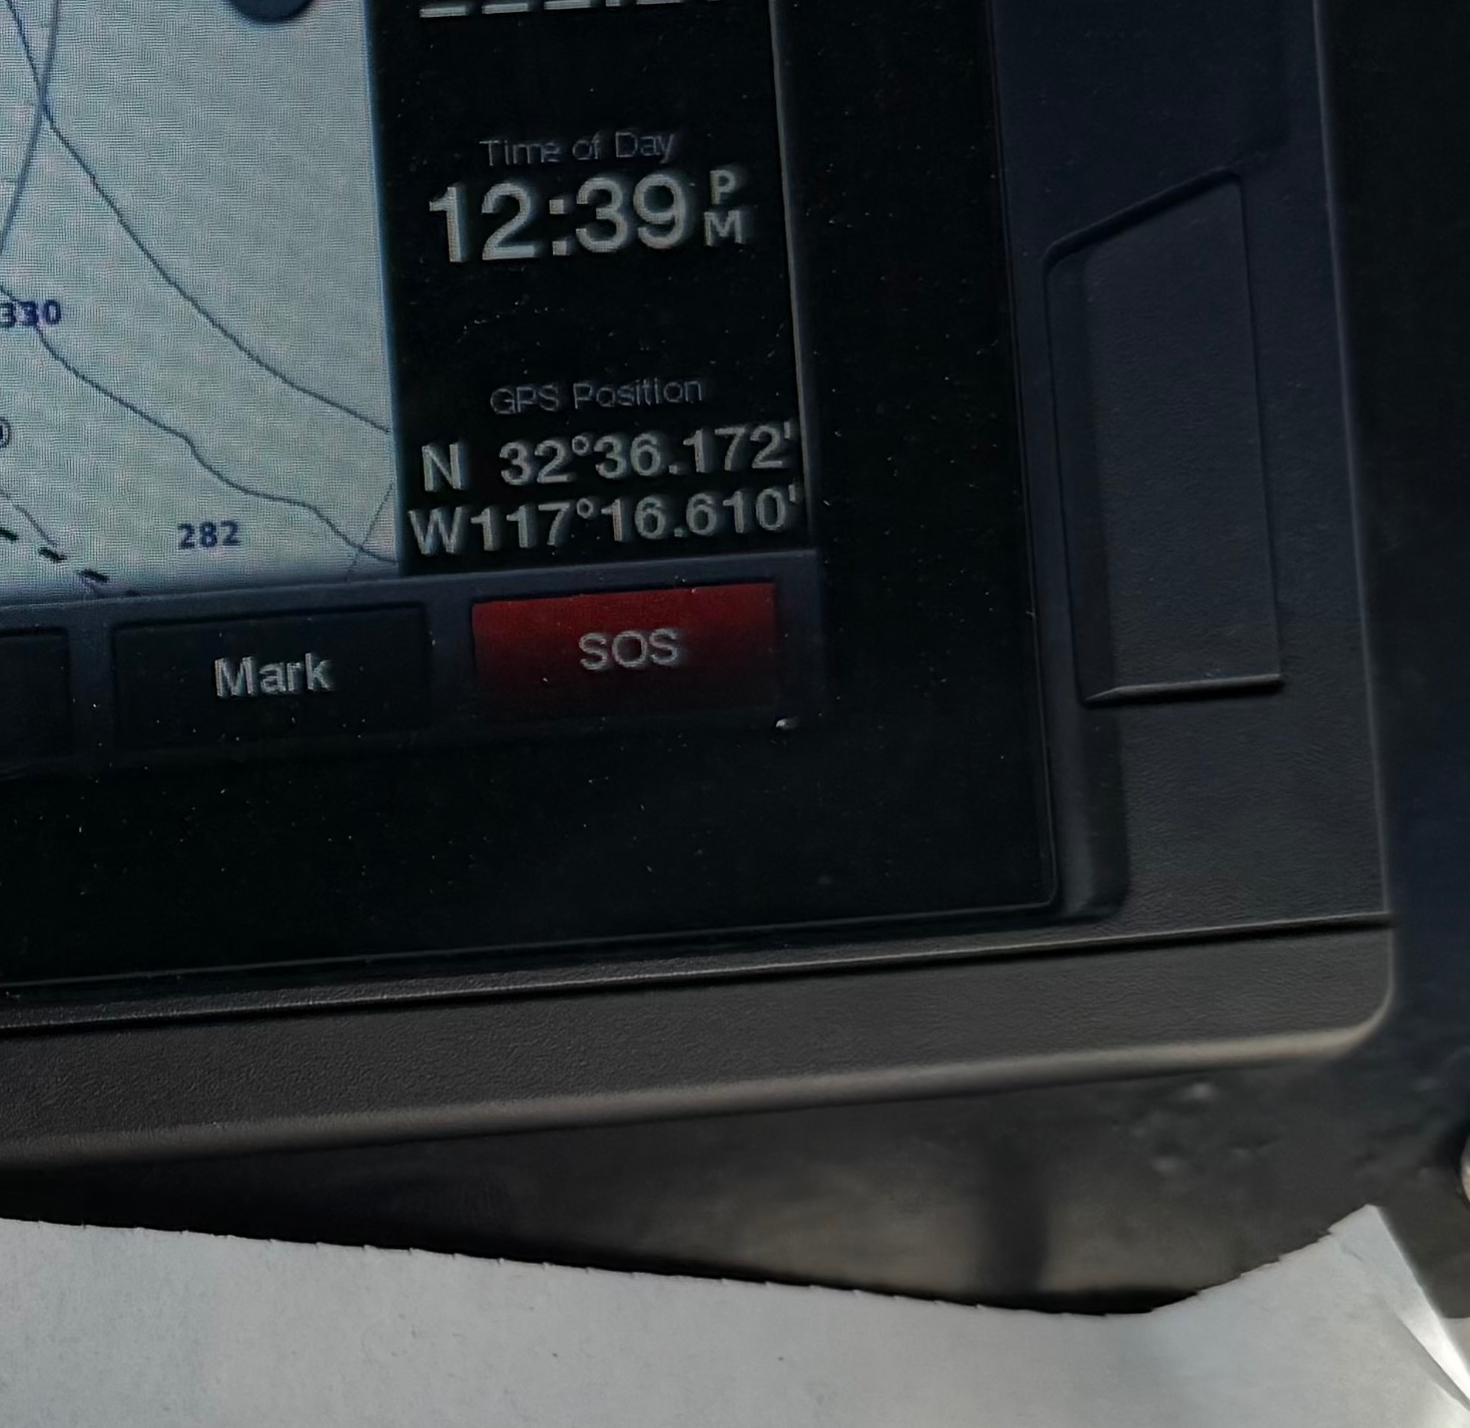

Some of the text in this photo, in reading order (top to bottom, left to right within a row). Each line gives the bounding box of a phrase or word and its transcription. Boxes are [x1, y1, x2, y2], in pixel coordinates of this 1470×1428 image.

[479, 130, 677, 167] Time of Day
[428, 173, 687, 263] 12:39
[490, 377, 706, 416] GPS Position
[422, 442, 464, 493] N
[177, 519, 241, 551] 282
[578, 629, 683, 671] SOS
[215, 652, 333, 697] Mark
